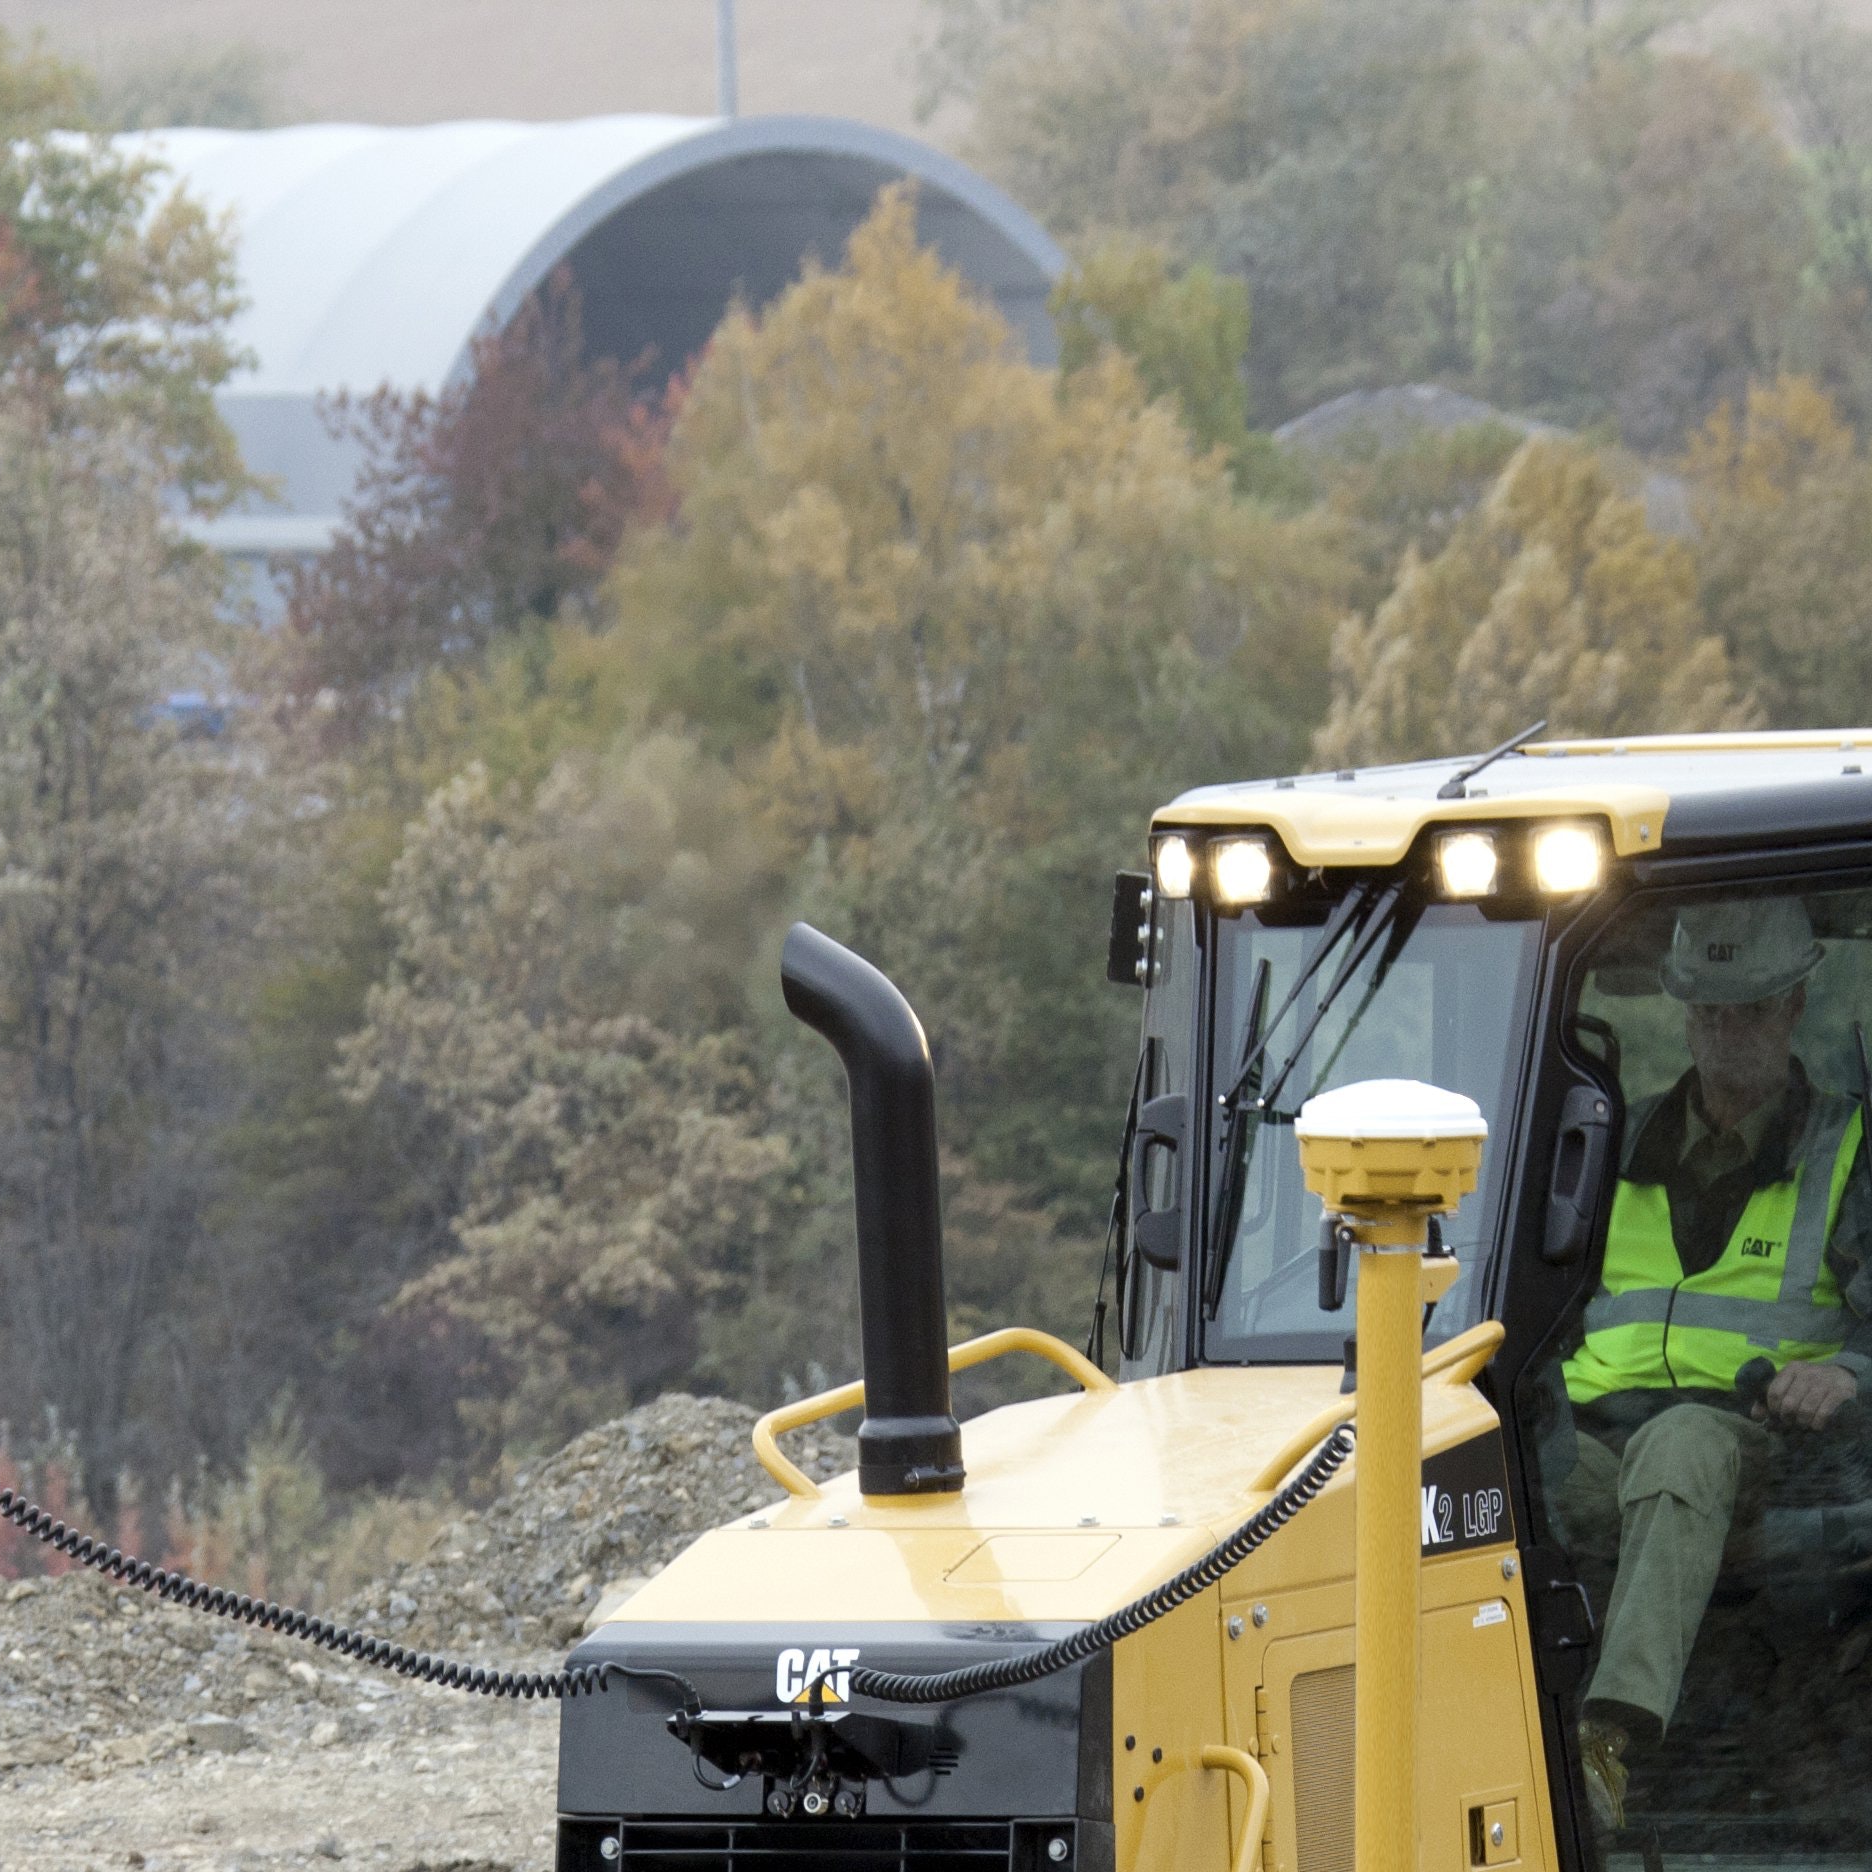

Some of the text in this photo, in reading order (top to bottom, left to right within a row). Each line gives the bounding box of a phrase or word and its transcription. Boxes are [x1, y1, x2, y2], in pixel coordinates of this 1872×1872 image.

[1741, 1236, 1776, 1258] CAT
[1462, 1487, 1503, 1539] LGP
[776, 1648, 860, 1703] CAT
